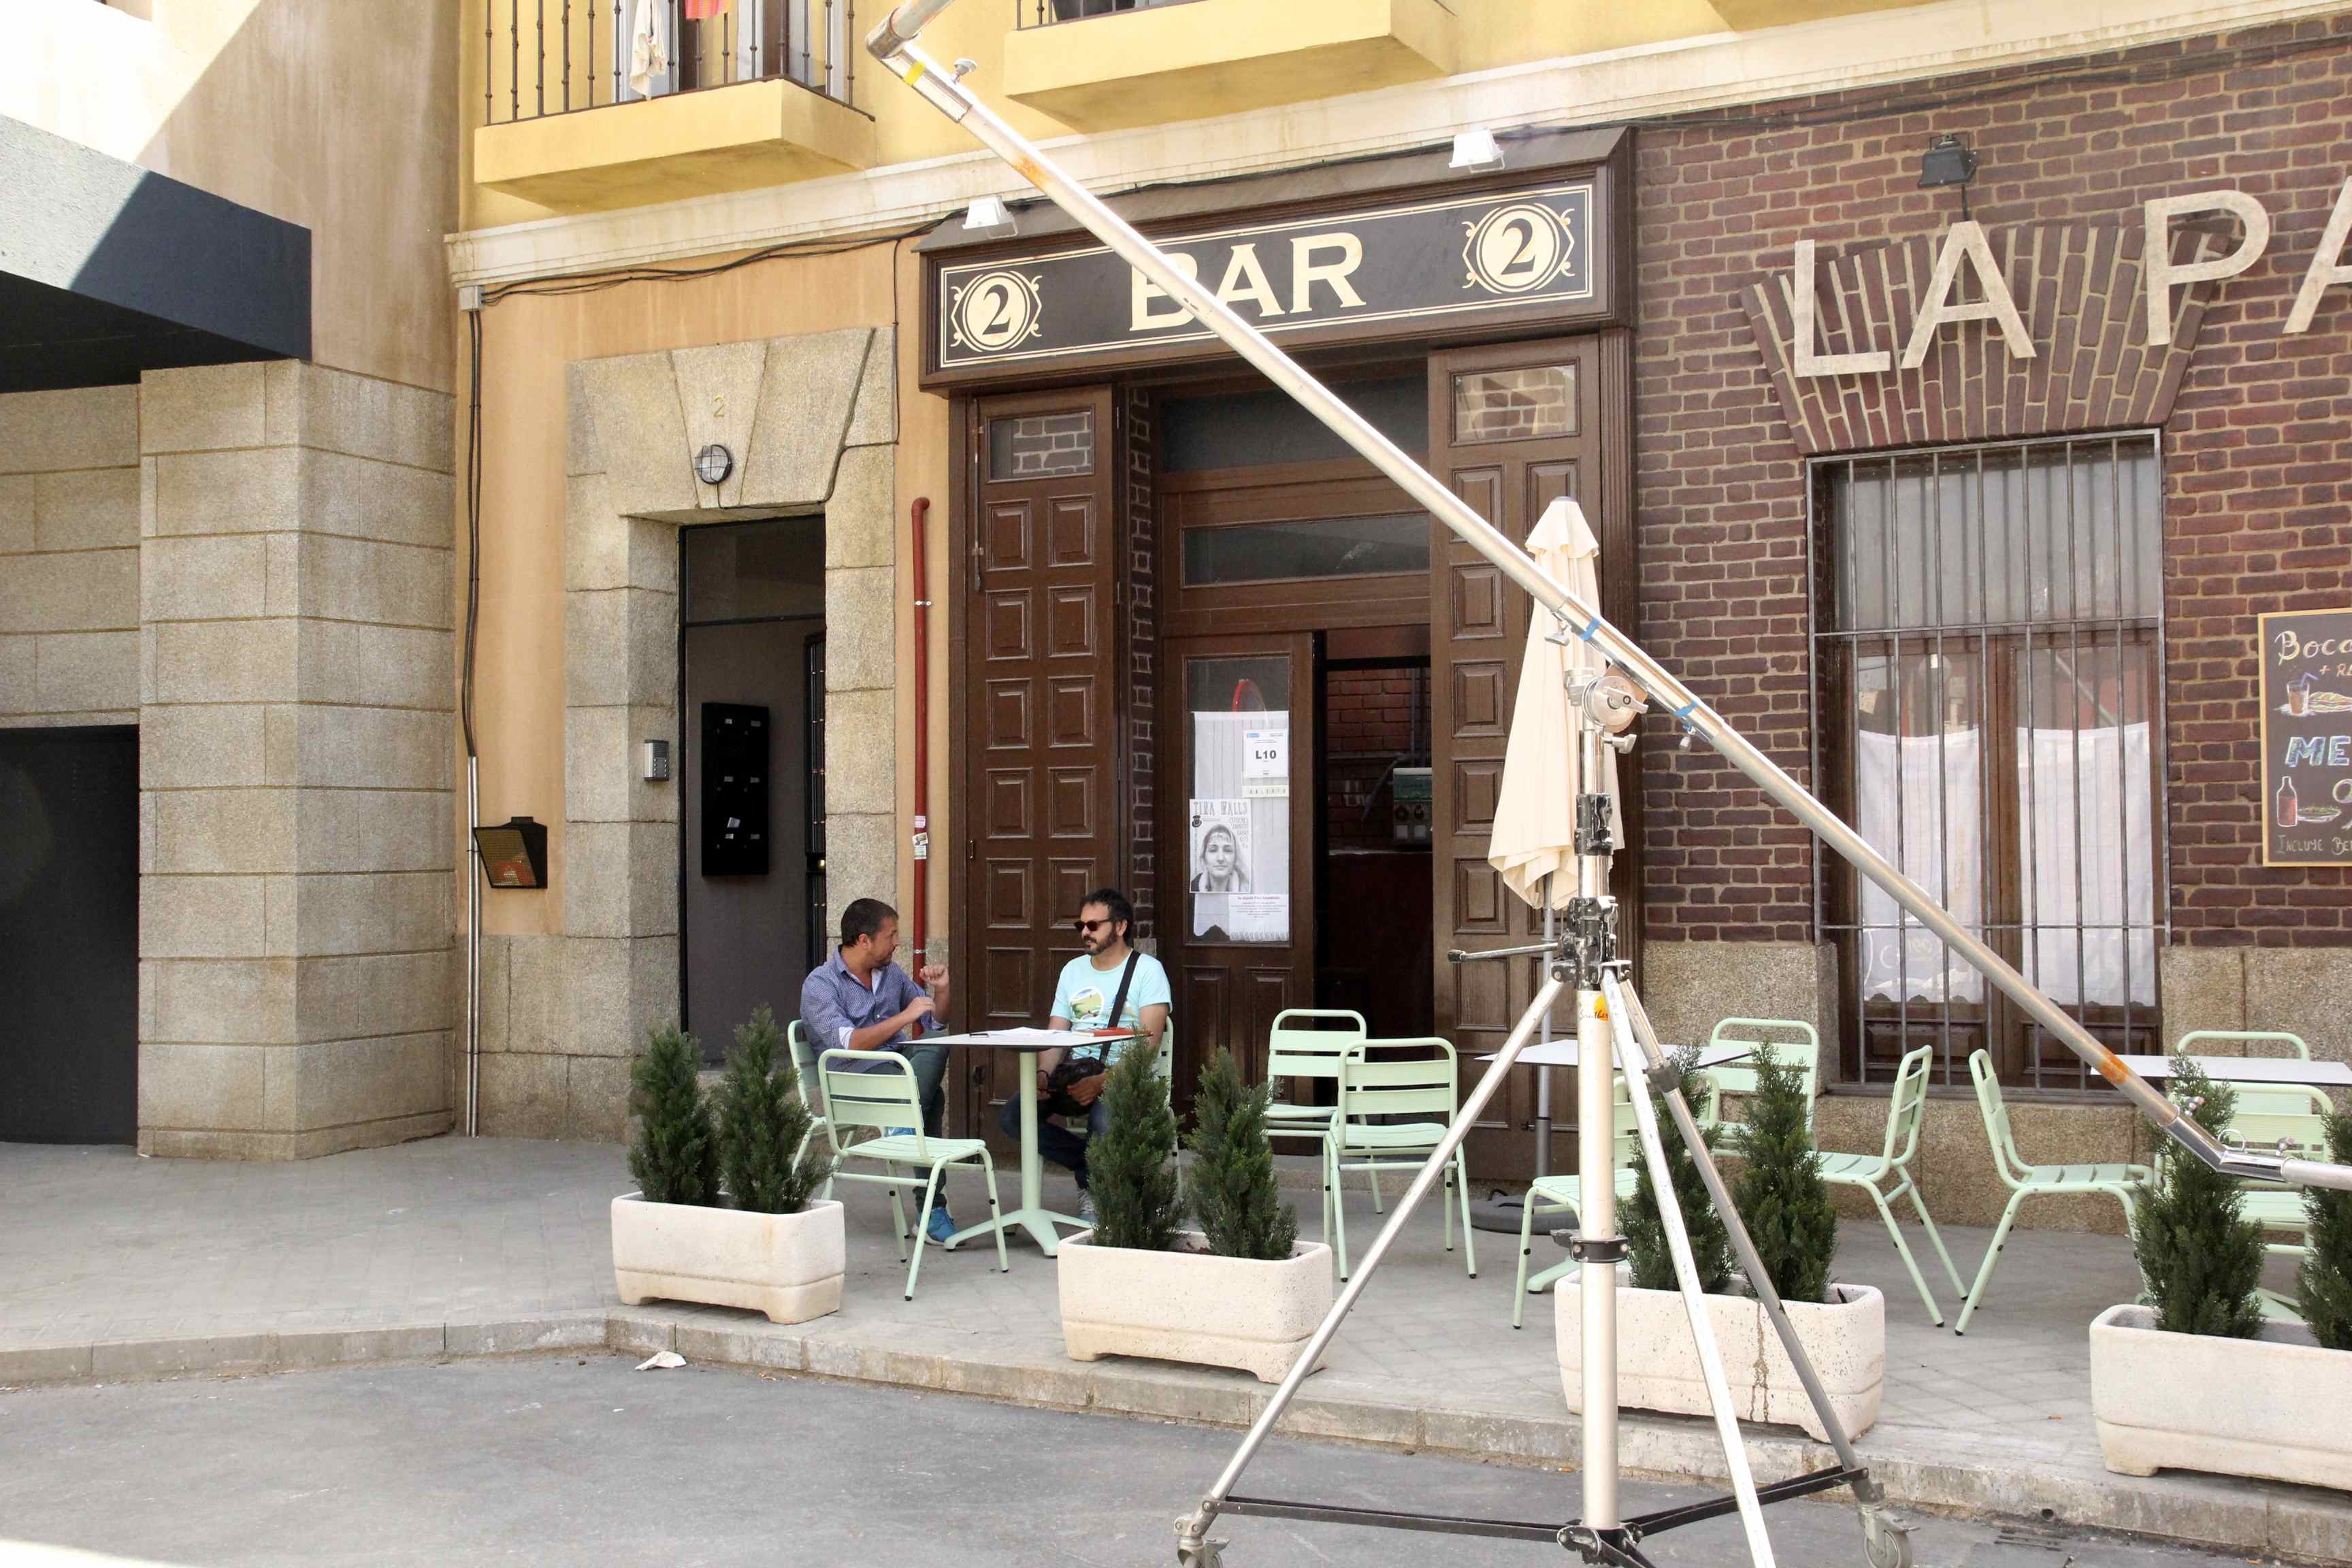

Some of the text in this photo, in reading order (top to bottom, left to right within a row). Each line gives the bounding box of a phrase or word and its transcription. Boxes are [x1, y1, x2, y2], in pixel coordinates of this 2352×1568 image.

[982, 226, 1536, 335] 2 BAR 2
[1793, 220, 2037, 378] LA
[713, 395, 725, 419] 2
[1255, 750, 1277, 760] L10
[2285, 736, 2351, 768] ME
[2331, 836, 2352, 855] BE
